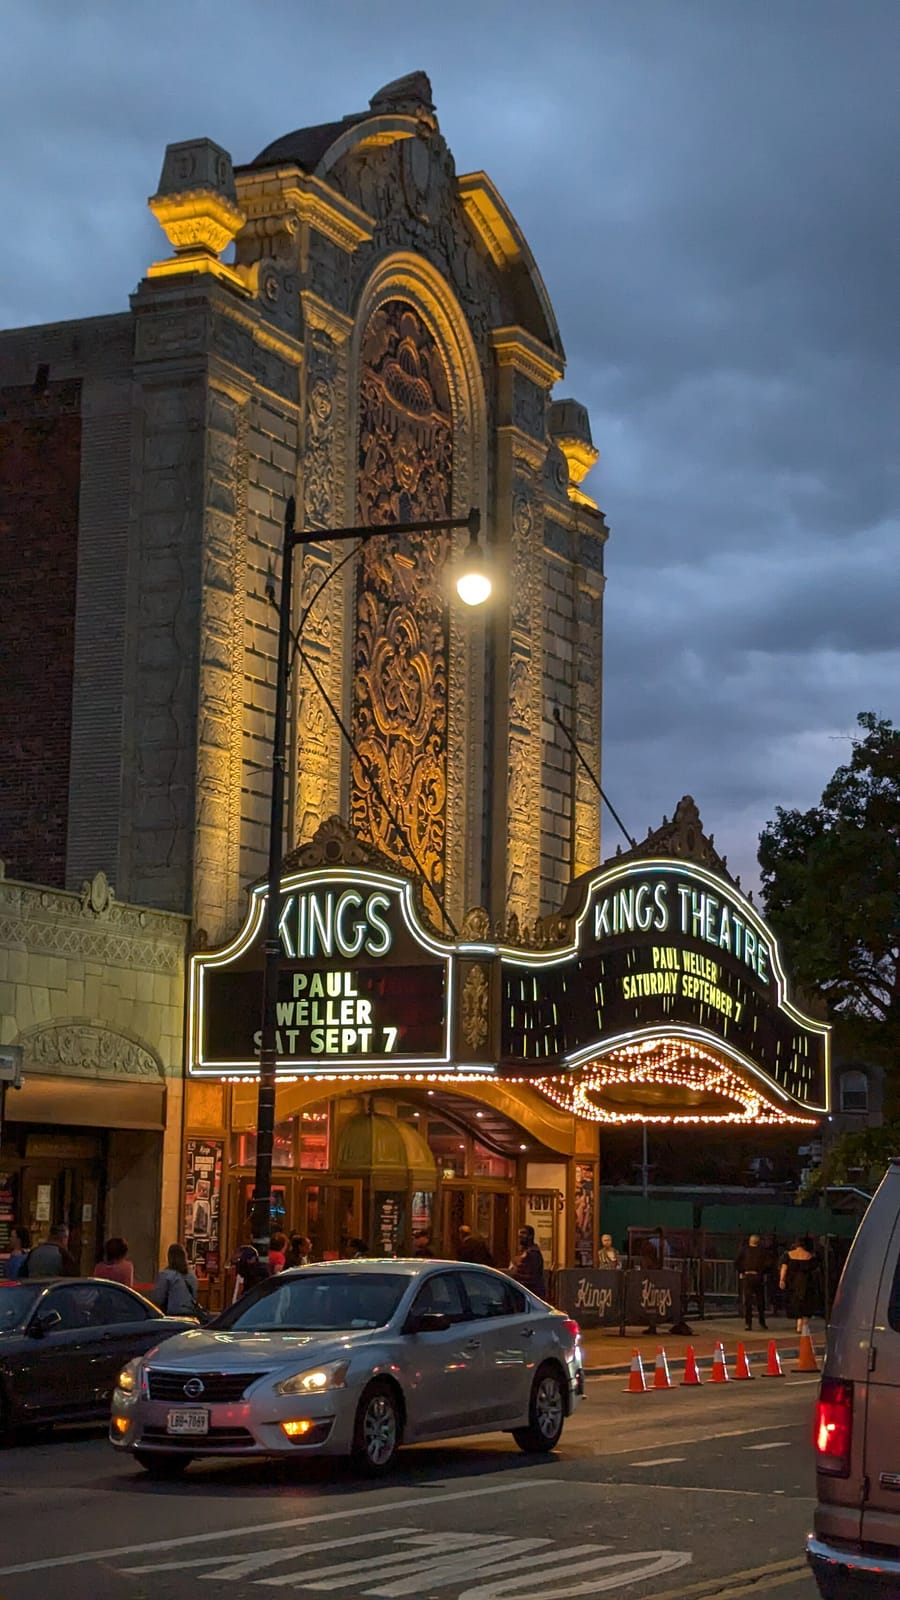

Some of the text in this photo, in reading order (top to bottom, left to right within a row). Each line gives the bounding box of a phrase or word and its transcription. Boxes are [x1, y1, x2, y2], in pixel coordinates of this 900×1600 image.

[278, 889, 392, 959] KINGS
[594, 883, 769, 984] KINGS THEATRE
[652, 946, 718, 982] PAUL WELLER
[292, 971, 358, 998] PAUL
[623, 971, 743, 1023] SATURDAY SEPTEMBER 7
[276, 999, 373, 1026] WELLER
[310, 1027, 372, 1054] SEPT
[383, 1027, 398, 1053] 7
[575, 1277, 612, 1317] Kings
[641, 1279, 672, 1316] Kings
